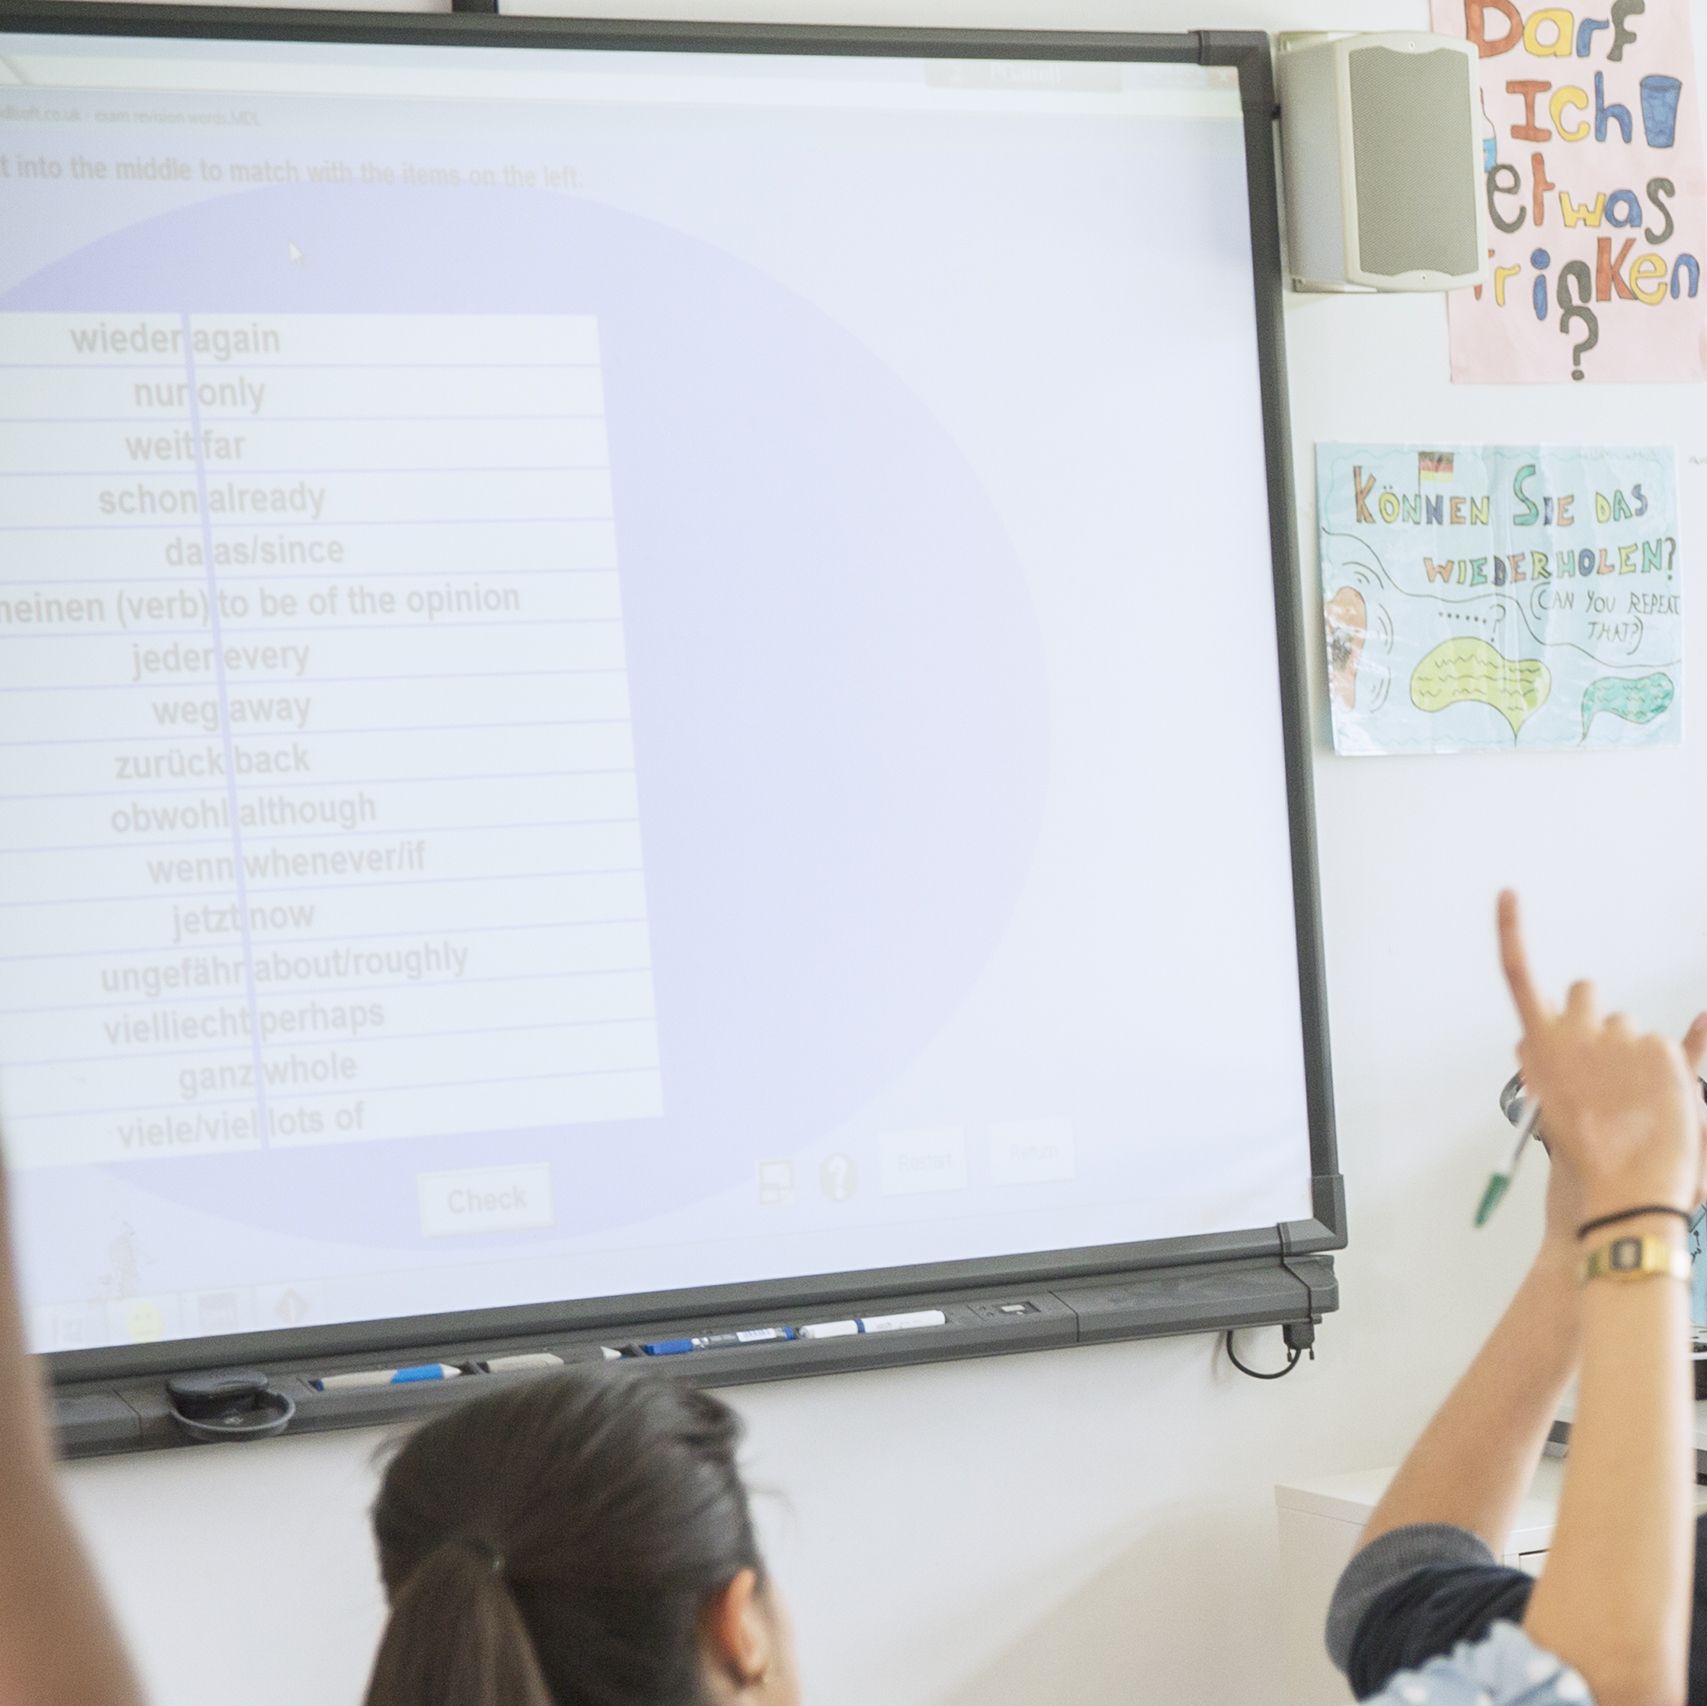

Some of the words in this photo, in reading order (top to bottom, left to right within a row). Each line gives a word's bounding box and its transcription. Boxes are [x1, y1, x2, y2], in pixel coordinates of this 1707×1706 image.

[1465, 0, 1645, 62] Darf
[1506, 70, 1633, 143] Ich
[18, 155, 62, 181] into
[70, 155, 108, 181] the
[115, 155, 192, 181] middle
[199, 157, 222, 182] to
[229, 158, 299, 184] match
[305, 160, 354, 186] with
[360, 160, 395, 187] the
[401, 162, 460, 188] items
[468, 168, 497, 188] on
[503, 165, 536, 189] the
[1486, 152, 1676, 245] etwas
[69, 323, 182, 354] wieder
[191, 324, 281, 362] again
[1559, 306, 1599, 381] ?
[134, 378, 187, 409] nur
[197, 376, 267, 415] only
[125, 430, 197, 462] weit
[201, 429, 246, 461] far
[98, 485, 198, 518] schon
[208, 481, 327, 520] already
[1352, 464, 1491, 527] KÖNNEN
[1512, 463, 1577, 528] SIE
[1594, 482, 1649, 525] DAS
[165, 536, 205, 568] da
[212, 534, 346, 568] as/since
[116, 587, 211, 630] (verb)
[219, 589, 250, 619] to
[260, 584, 300, 619] be
[308, 583, 339, 617] of
[348, 583, 397, 616] the
[406, 581, 521, 624] opinion
[1585, 588, 1617, 616] YOU
[132, 641, 212, 682] jeder
[222, 642, 311, 677] every
[151, 700, 219, 735] weg
[228, 696, 312, 729] away
[113, 746, 226, 782] zurück
[234, 742, 311, 776] back
[110, 798, 230, 833] obwohl
[238, 791, 378, 831] although
[146, 853, 235, 886] wenn
[240, 839, 428, 880] whenever/if
[170, 902, 241, 944] jetzt
[250, 903, 316, 932] now
[100, 956, 246, 998] ungefähr
[255, 940, 469, 987] about/roughly
[102, 1005, 252, 1046] vielliecht
[258, 1000, 386, 1042] perhaps
[178, 1061, 256, 1101] ganz
[261, 1050, 359, 1086] whole
[116, 1106, 260, 1150] viele/viel
[267, 1105, 325, 1137] lots
[335, 1099, 366, 1132] of
[446, 1183, 529, 1216] Check
